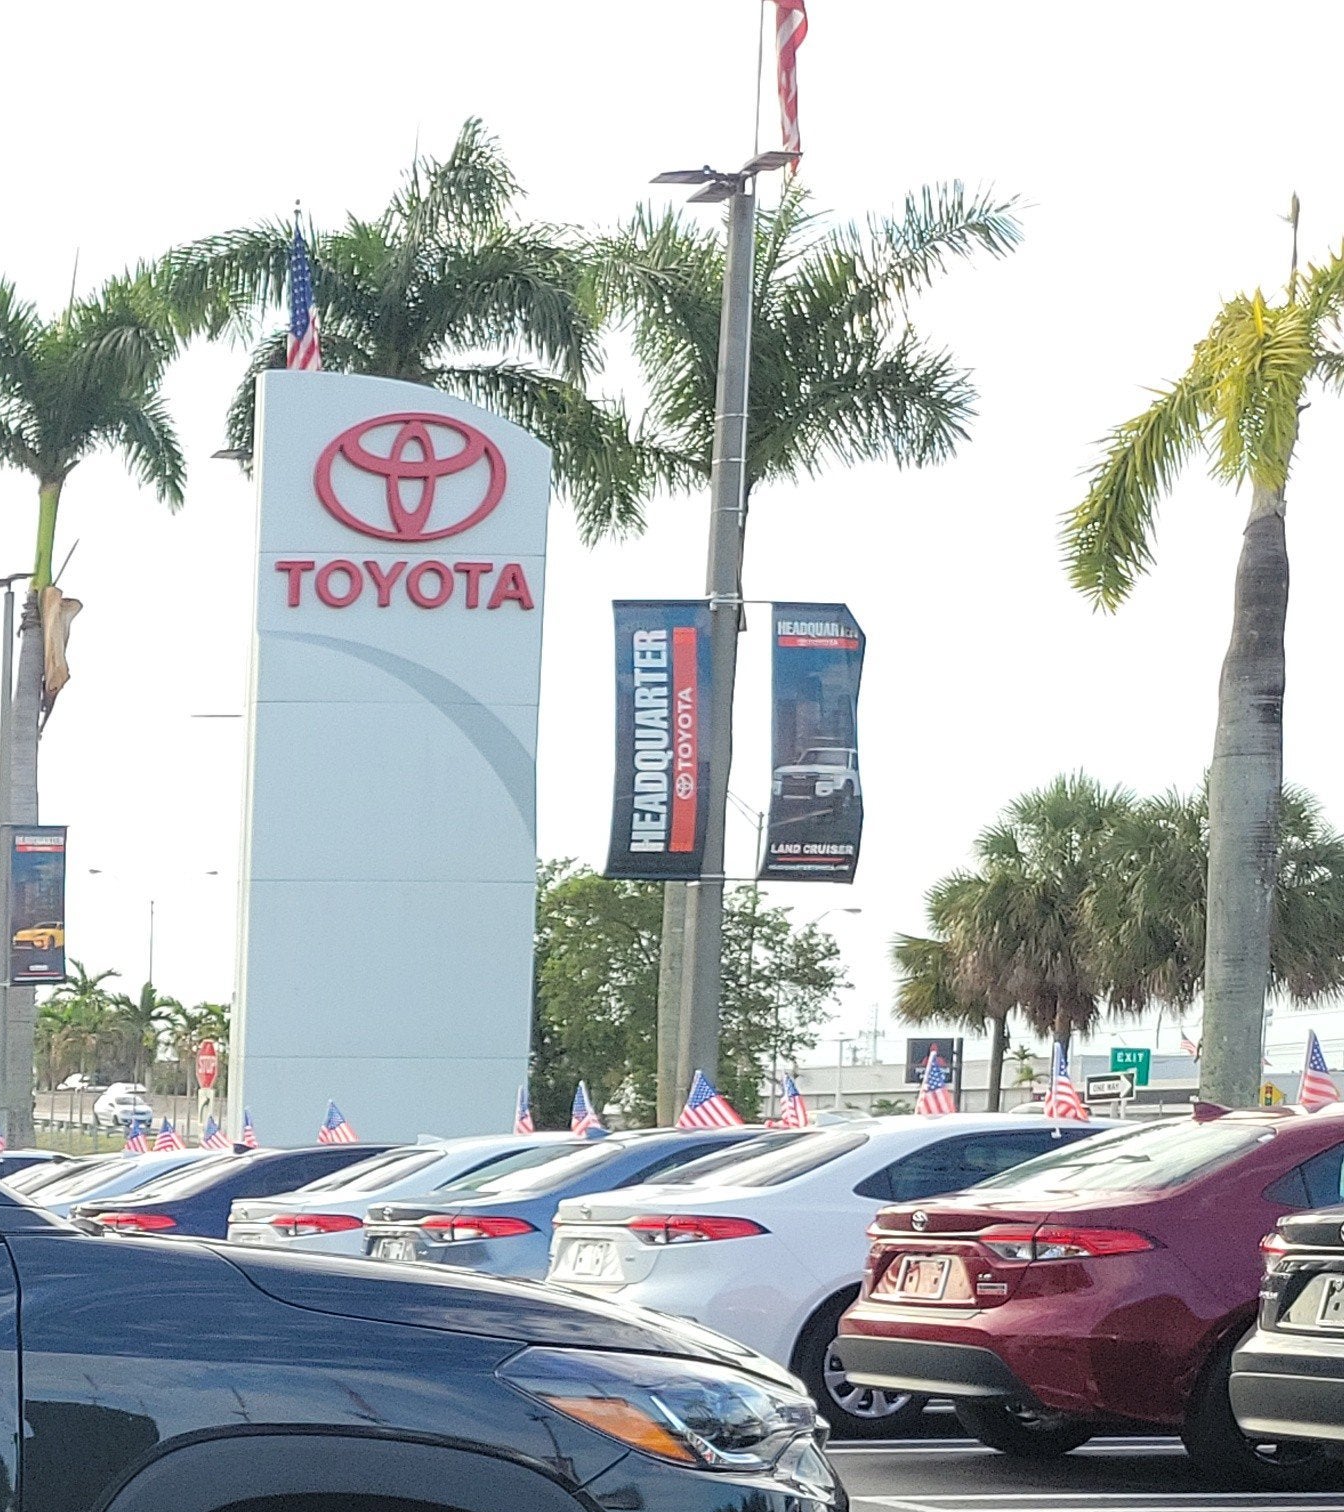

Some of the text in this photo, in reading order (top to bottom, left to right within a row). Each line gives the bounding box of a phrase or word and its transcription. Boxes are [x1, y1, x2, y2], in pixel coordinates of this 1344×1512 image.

[275, 559, 534, 610] TOYOTA
[678, 687, 694, 770] TOYOTA
[629, 629, 673, 852] HEADQUARTER
[770, 843, 853, 855] LAND CRUISER
[199, 1056, 216, 1074] STOP
[1116, 1052, 1144, 1063] EXIT
[1093, 1082, 1120, 1092] ONE WAY
